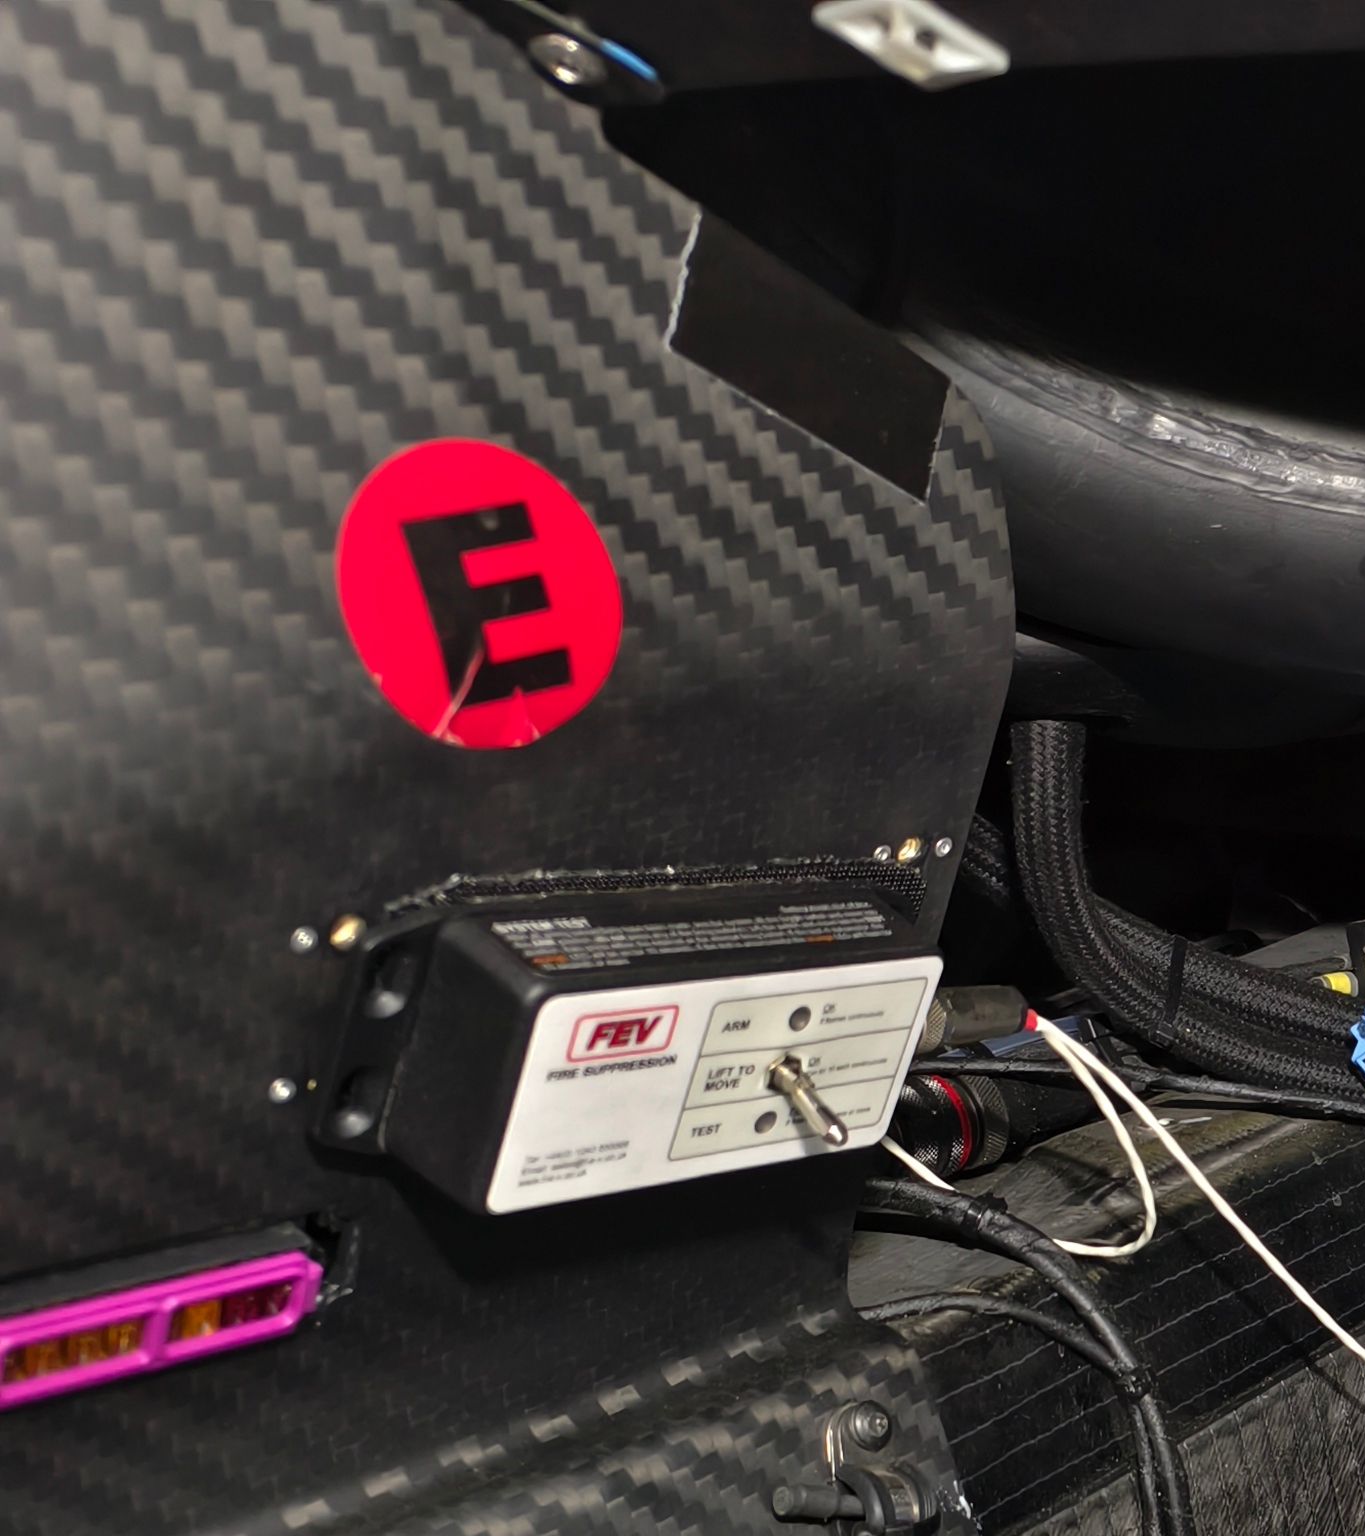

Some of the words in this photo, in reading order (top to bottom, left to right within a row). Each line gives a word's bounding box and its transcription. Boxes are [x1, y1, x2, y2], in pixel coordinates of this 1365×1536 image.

[400, 501, 575, 706] E
[586, 1015, 663, 1051] FEV
[721, 1019, 751, 1033] ARM
[546, 1067, 580, 1083] FIRE
[582, 1054, 678, 1078] SUPPRESSION
[708, 1067, 734, 1080] LIFT
[737, 1064, 755, 1076] TO
[703, 1078, 741, 1093] MOVE
[691, 1123, 722, 1138] TEST
